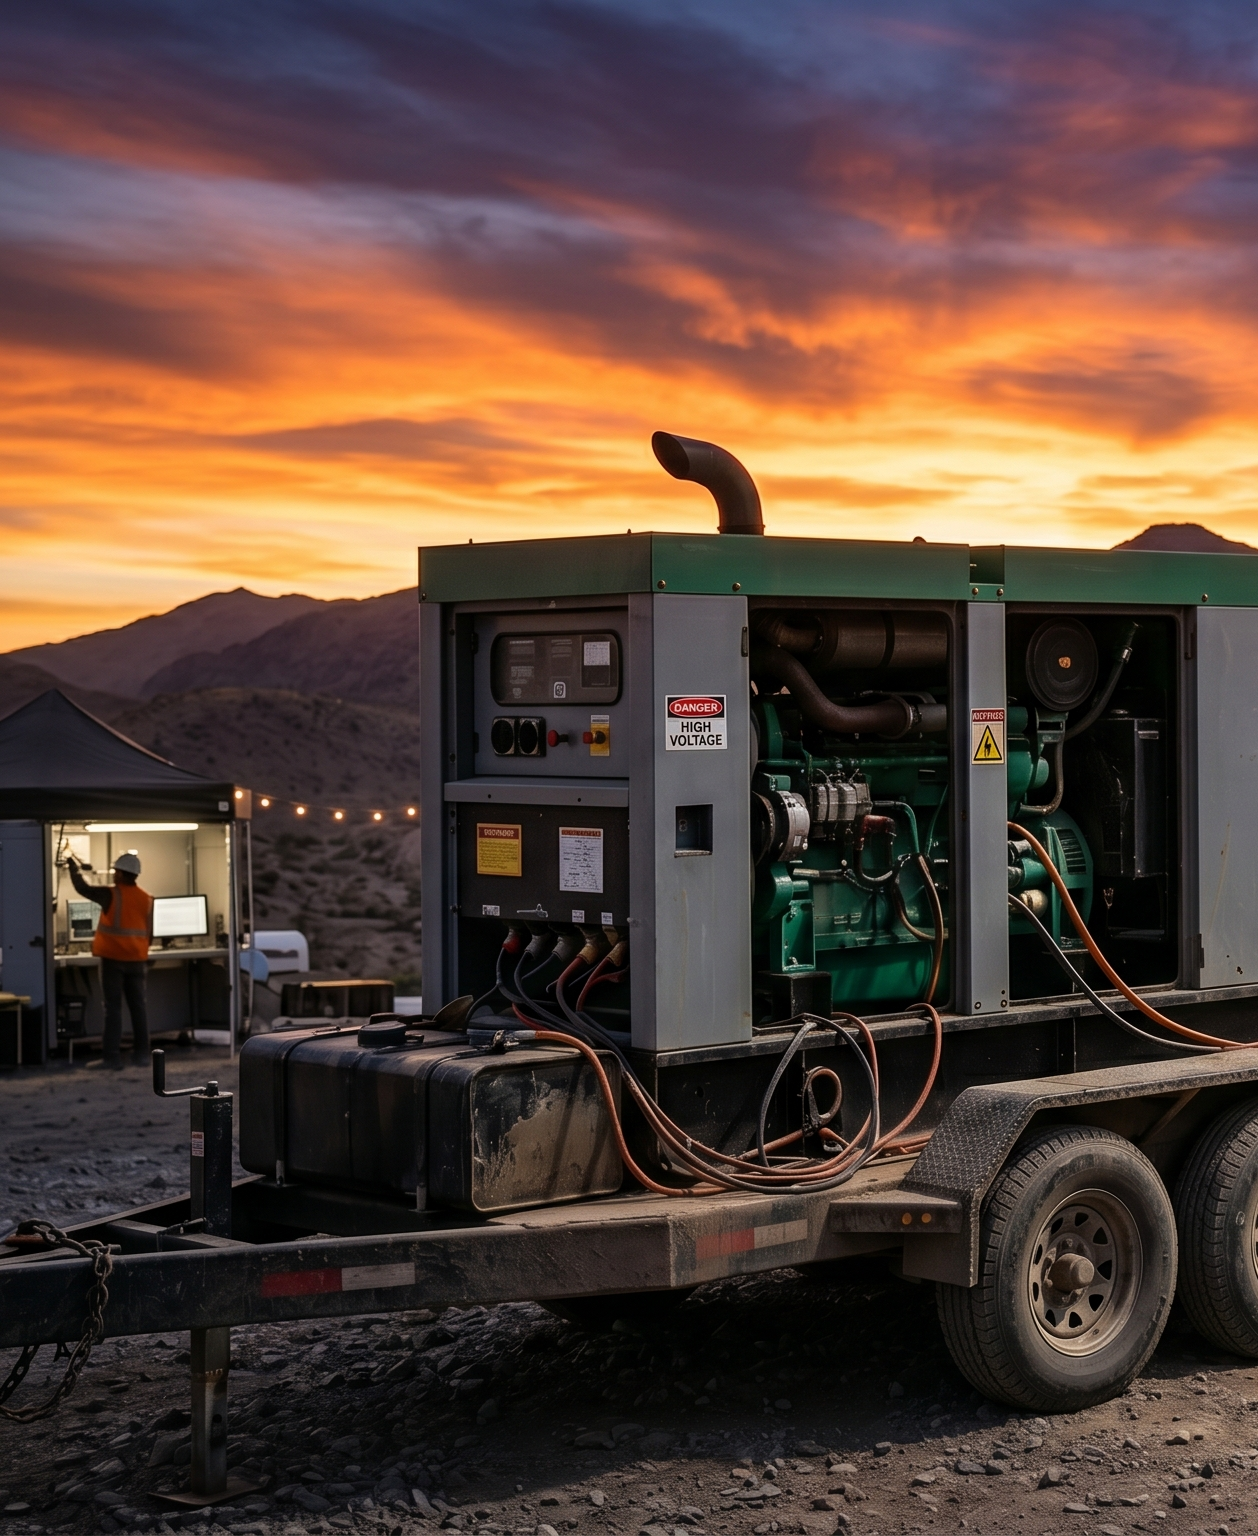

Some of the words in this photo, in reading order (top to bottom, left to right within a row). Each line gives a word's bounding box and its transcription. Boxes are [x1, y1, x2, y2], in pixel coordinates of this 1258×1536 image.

[674, 703, 718, 712] DANGER
[681, 721, 711, 733] HIGH
[669, 734, 723, 746] VOLTAGE
